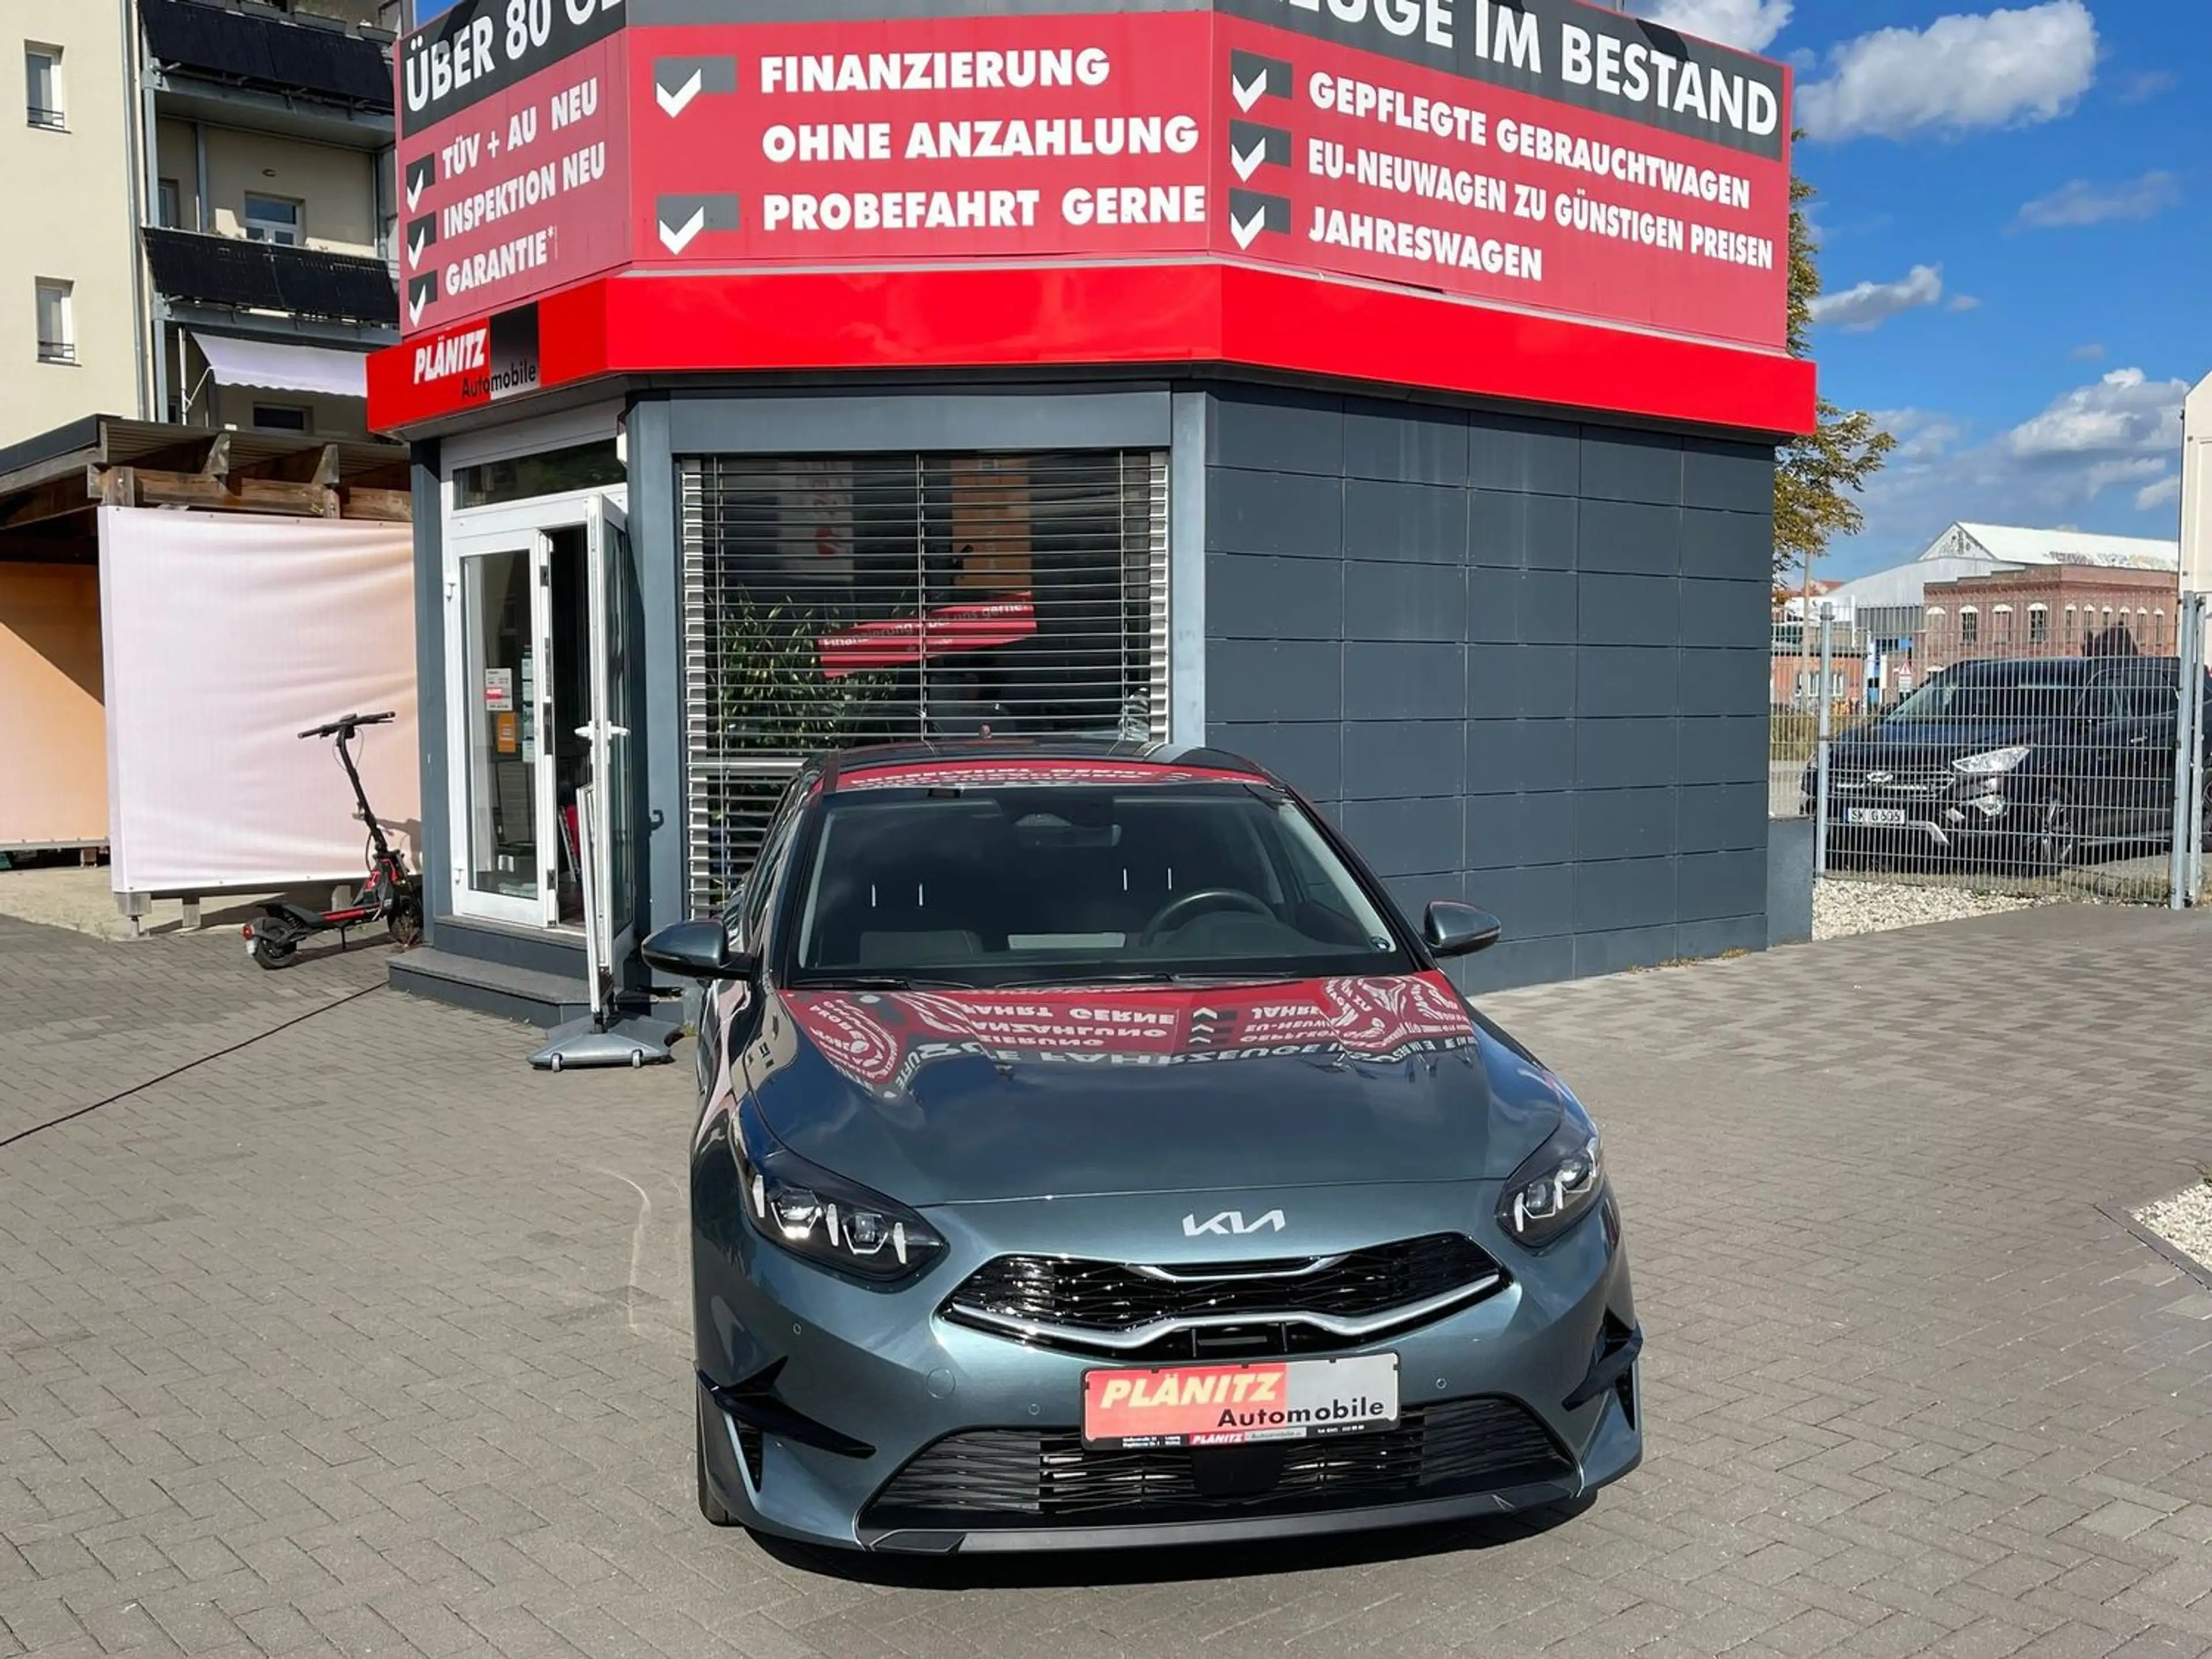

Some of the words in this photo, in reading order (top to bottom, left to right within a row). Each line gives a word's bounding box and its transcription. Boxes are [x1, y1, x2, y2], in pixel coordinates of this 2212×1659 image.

[406, 16, 495, 112] ÜBER
[506, 0, 551, 60] 80
[761, 48, 1109, 93] FINANZIERUNG
[1475, 0, 1542, 74] IM
[1562, 24, 1777, 135] BESTAND
[442, 133, 480, 179] TÜV
[488, 131, 499, 158] +
[507, 107, 536, 151] AU
[551, 77, 597, 131] NEU
[762, 123, 891, 163] OHNE
[904, 115, 1199, 159] ANZAHLUNG
[1309, 71, 1487, 146] GEPFLEGTE
[1497, 118, 1750, 210] GEBRAUCHTWAGEN
[444, 162, 556, 239] INSPEKTION
[563, 141, 605, 191] NEU
[763, 190, 1039, 231] PROBEFAHRT
[1062, 185, 1206, 226] GERNE
[1308, 138, 1506, 213] EU-NEUWAGEN
[1514, 184, 1547, 221] ZU
[1554, 190, 1683, 251] GÜNSTIGEN
[1690, 225, 1772, 270] PREISEN
[1308, 206, 1542, 281] JAHRESWAGEN
[414, 328, 487, 385] PLÄNITZ
[462, 359, 536, 398] Automobile
[1099, 1372, 1283, 1410] PLÄNITZ
[1217, 1397, 1384, 1427] Automobile
